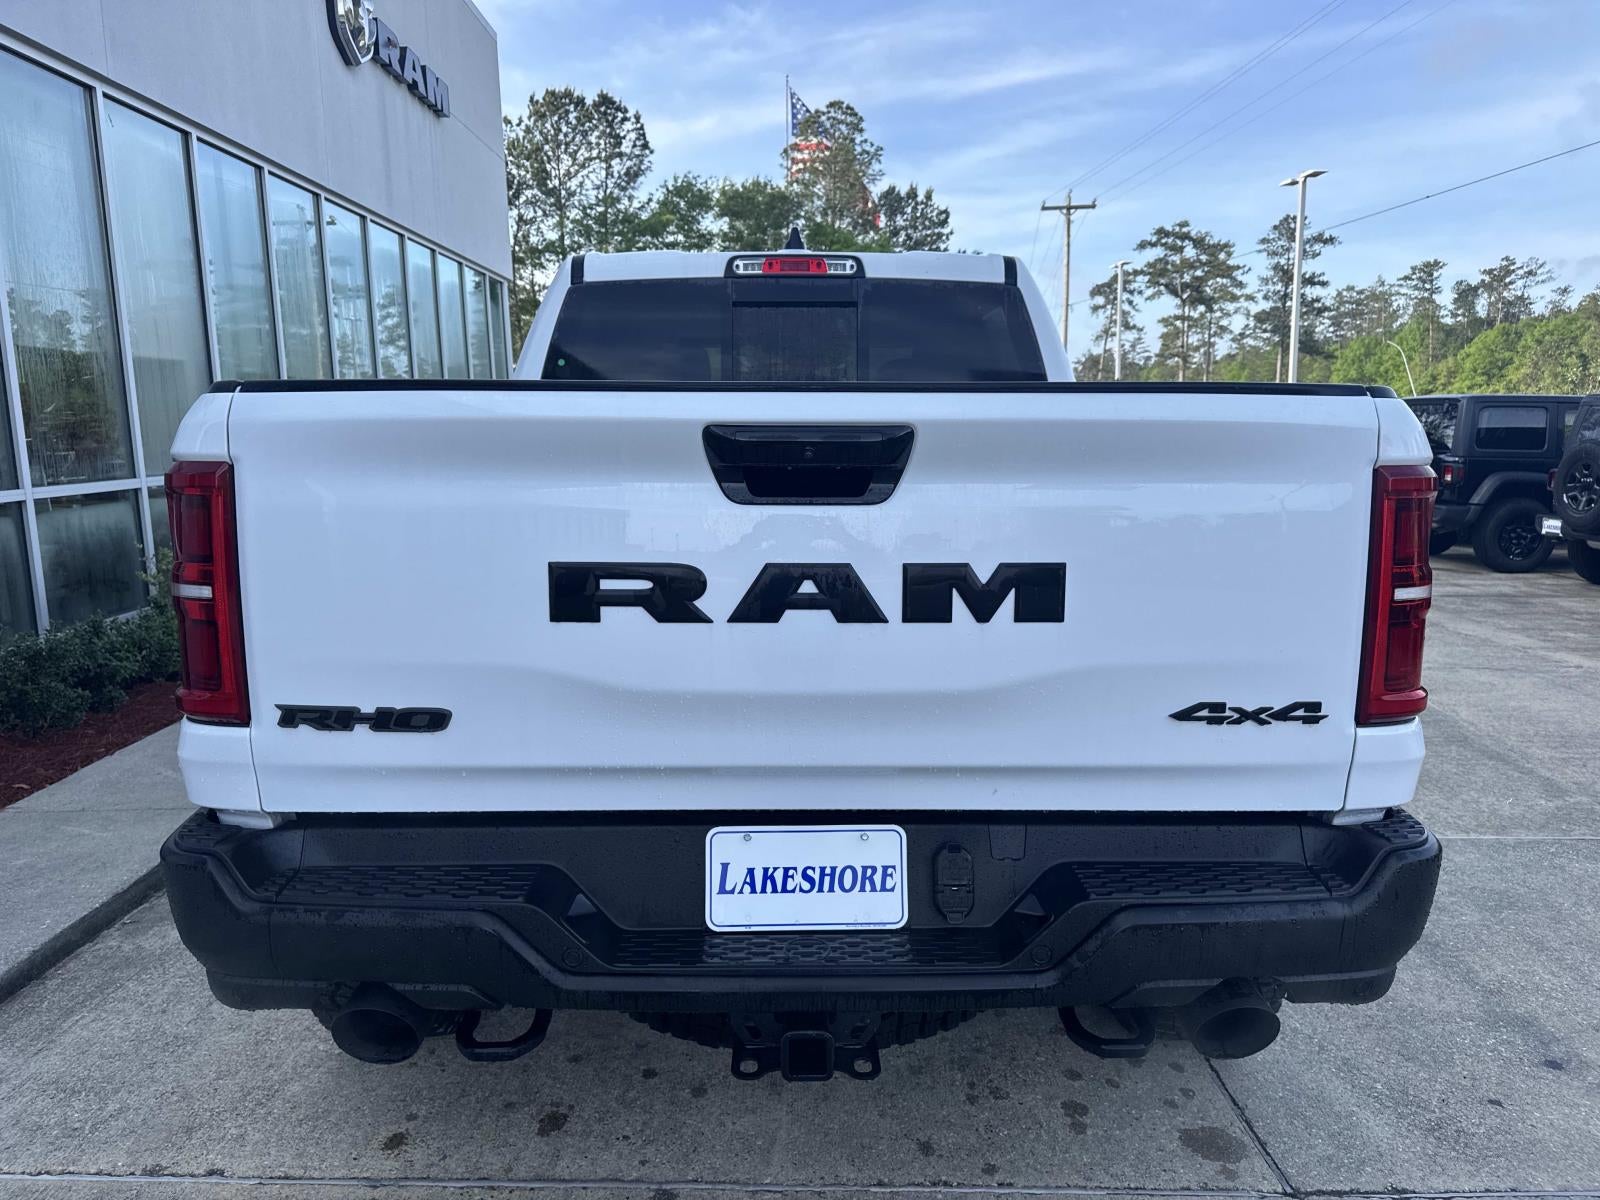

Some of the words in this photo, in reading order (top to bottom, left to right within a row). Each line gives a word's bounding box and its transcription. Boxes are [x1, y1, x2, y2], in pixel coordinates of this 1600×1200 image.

[372, 18, 450, 117] RAM
[548, 562, 1066, 623] RAM
[274, 704, 453, 733] RHO
[1168, 701, 1330, 726] 4x4
[716, 862, 898, 895] LAKESHORE
